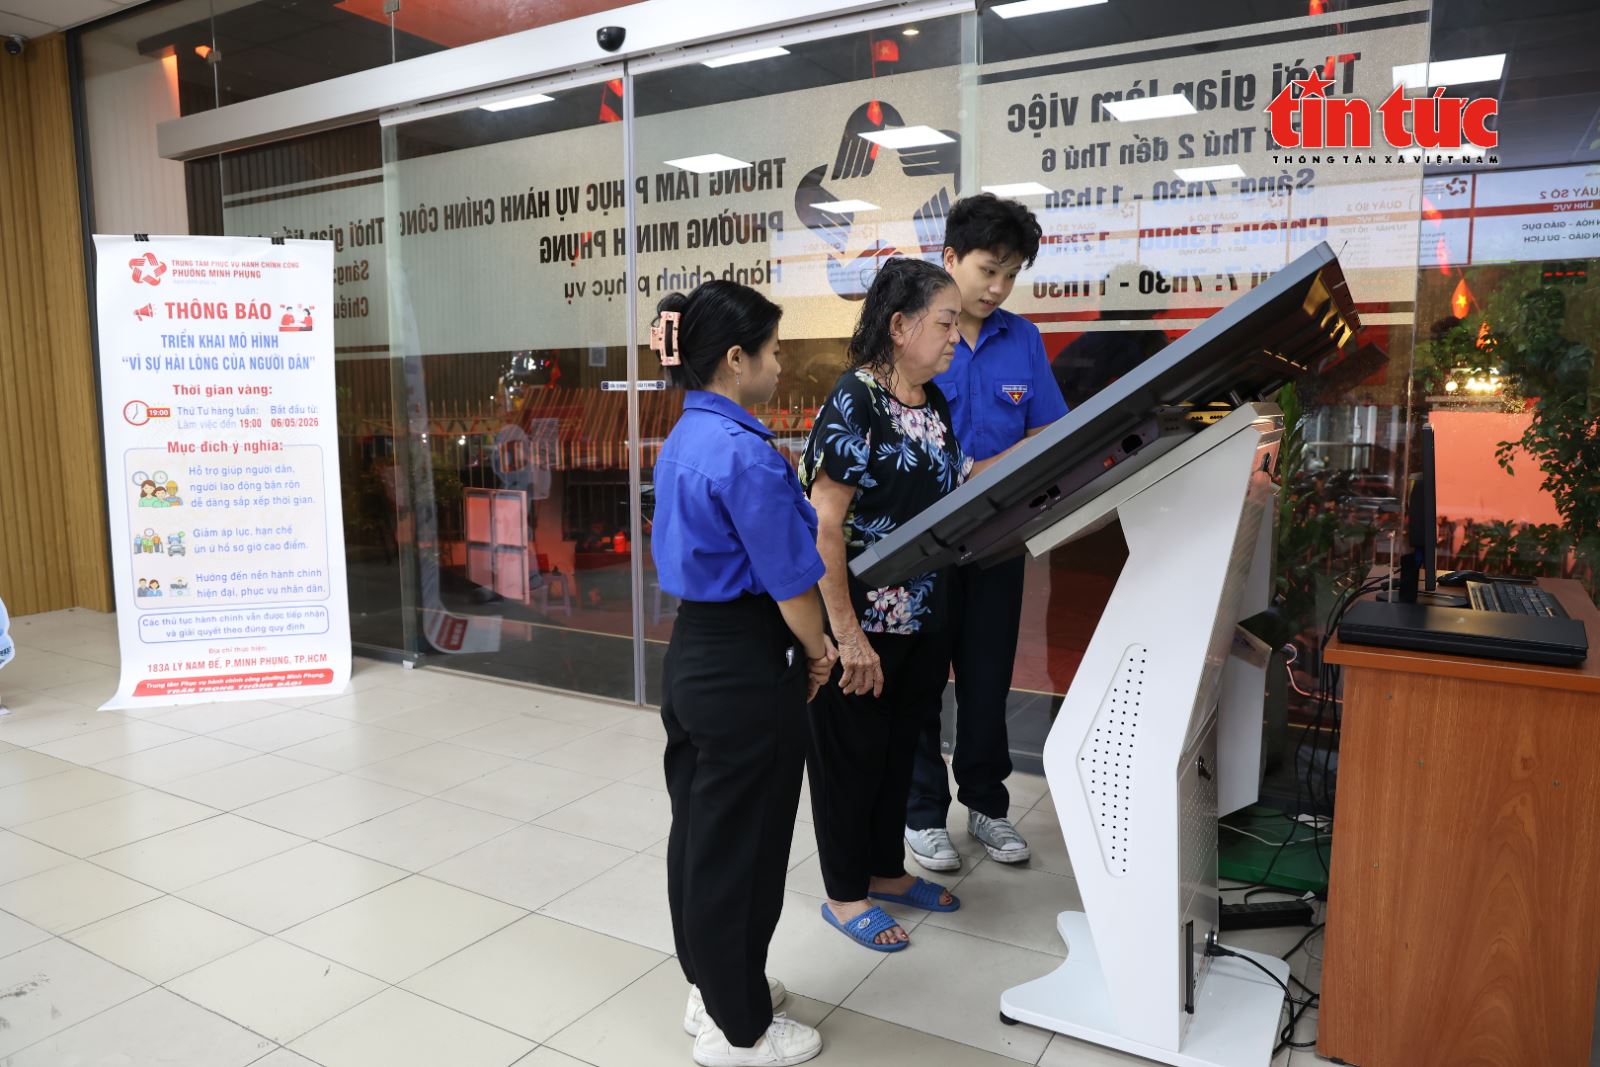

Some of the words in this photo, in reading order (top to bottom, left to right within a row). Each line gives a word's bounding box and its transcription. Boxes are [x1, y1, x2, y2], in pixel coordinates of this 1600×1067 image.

[164, 298, 228, 320] THÔNG
[235, 298, 272, 320] BÁO
[161, 329, 195, 349] TRIỂN
[199, 334, 225, 349] KHAI
[229, 331, 247, 349] MÔ
[251, 331, 279, 349] HÌNH
[145, 354, 161, 374] SỰ
[165, 353, 185, 370] HÀI
[189, 353, 219, 371] LÒNG
[222, 352, 246, 370] CỦA
[250, 353, 284, 370] NGƯỜI
[172, 383, 200, 396] Thời
[205, 385, 233, 398] gian
[237, 384, 273, 398] vàng:
[149, 408, 169, 417] 19:00
[239, 418, 262, 428] 19:00
[270, 417, 319, 428] 06/05/2026
[167, 440, 196, 456] Mục
[200, 439, 228, 453] đích
[232, 440, 240, 455] ý
[243, 438, 284, 454] nghĩa:
[148, 663, 170, 673] 183A
[172, 660, 183, 672] LÝ
[185, 661, 206, 671] NAM
[225, 657, 257, 669] P.MINH
[294, 653, 328, 665] TP.HCM
